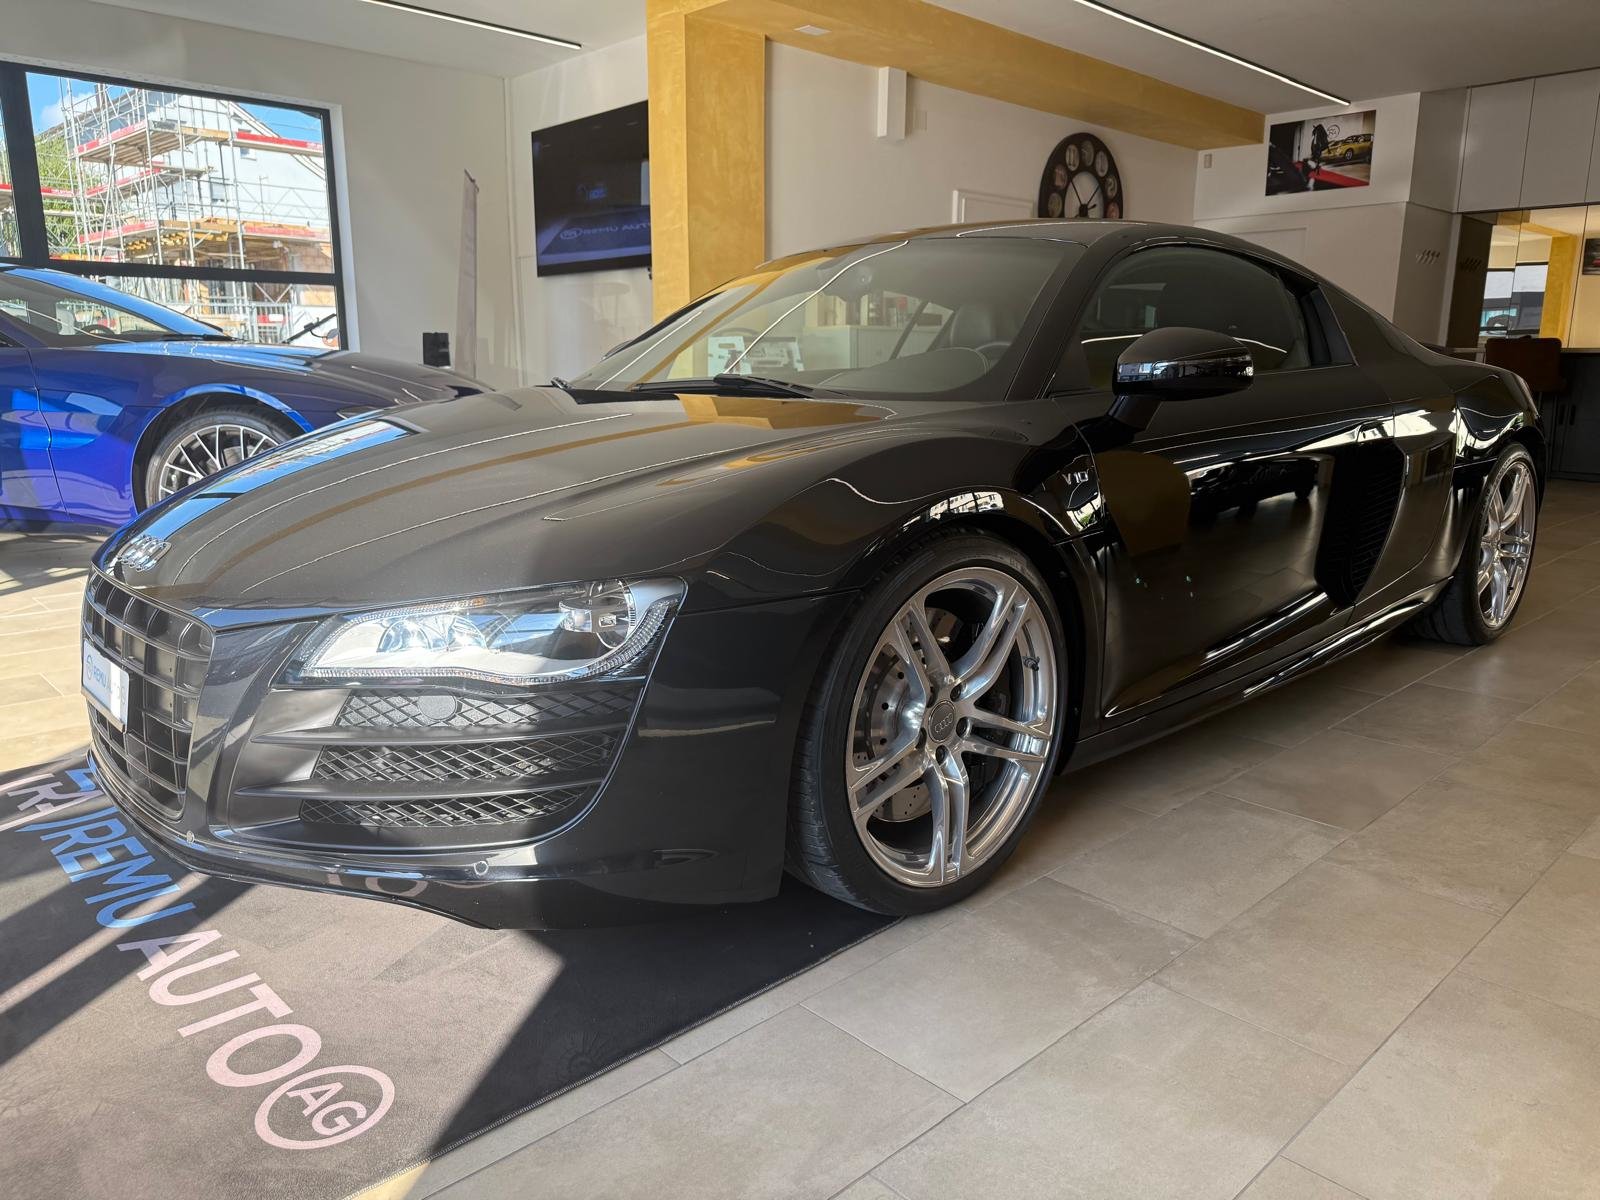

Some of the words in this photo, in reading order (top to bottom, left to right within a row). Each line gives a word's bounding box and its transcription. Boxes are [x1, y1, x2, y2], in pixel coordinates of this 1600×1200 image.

[1062, 472, 1089, 485] V10
[40, 818, 196, 929] REMU
[117, 929, 322, 1088] AUTO
[286, 1081, 368, 1136] AG
